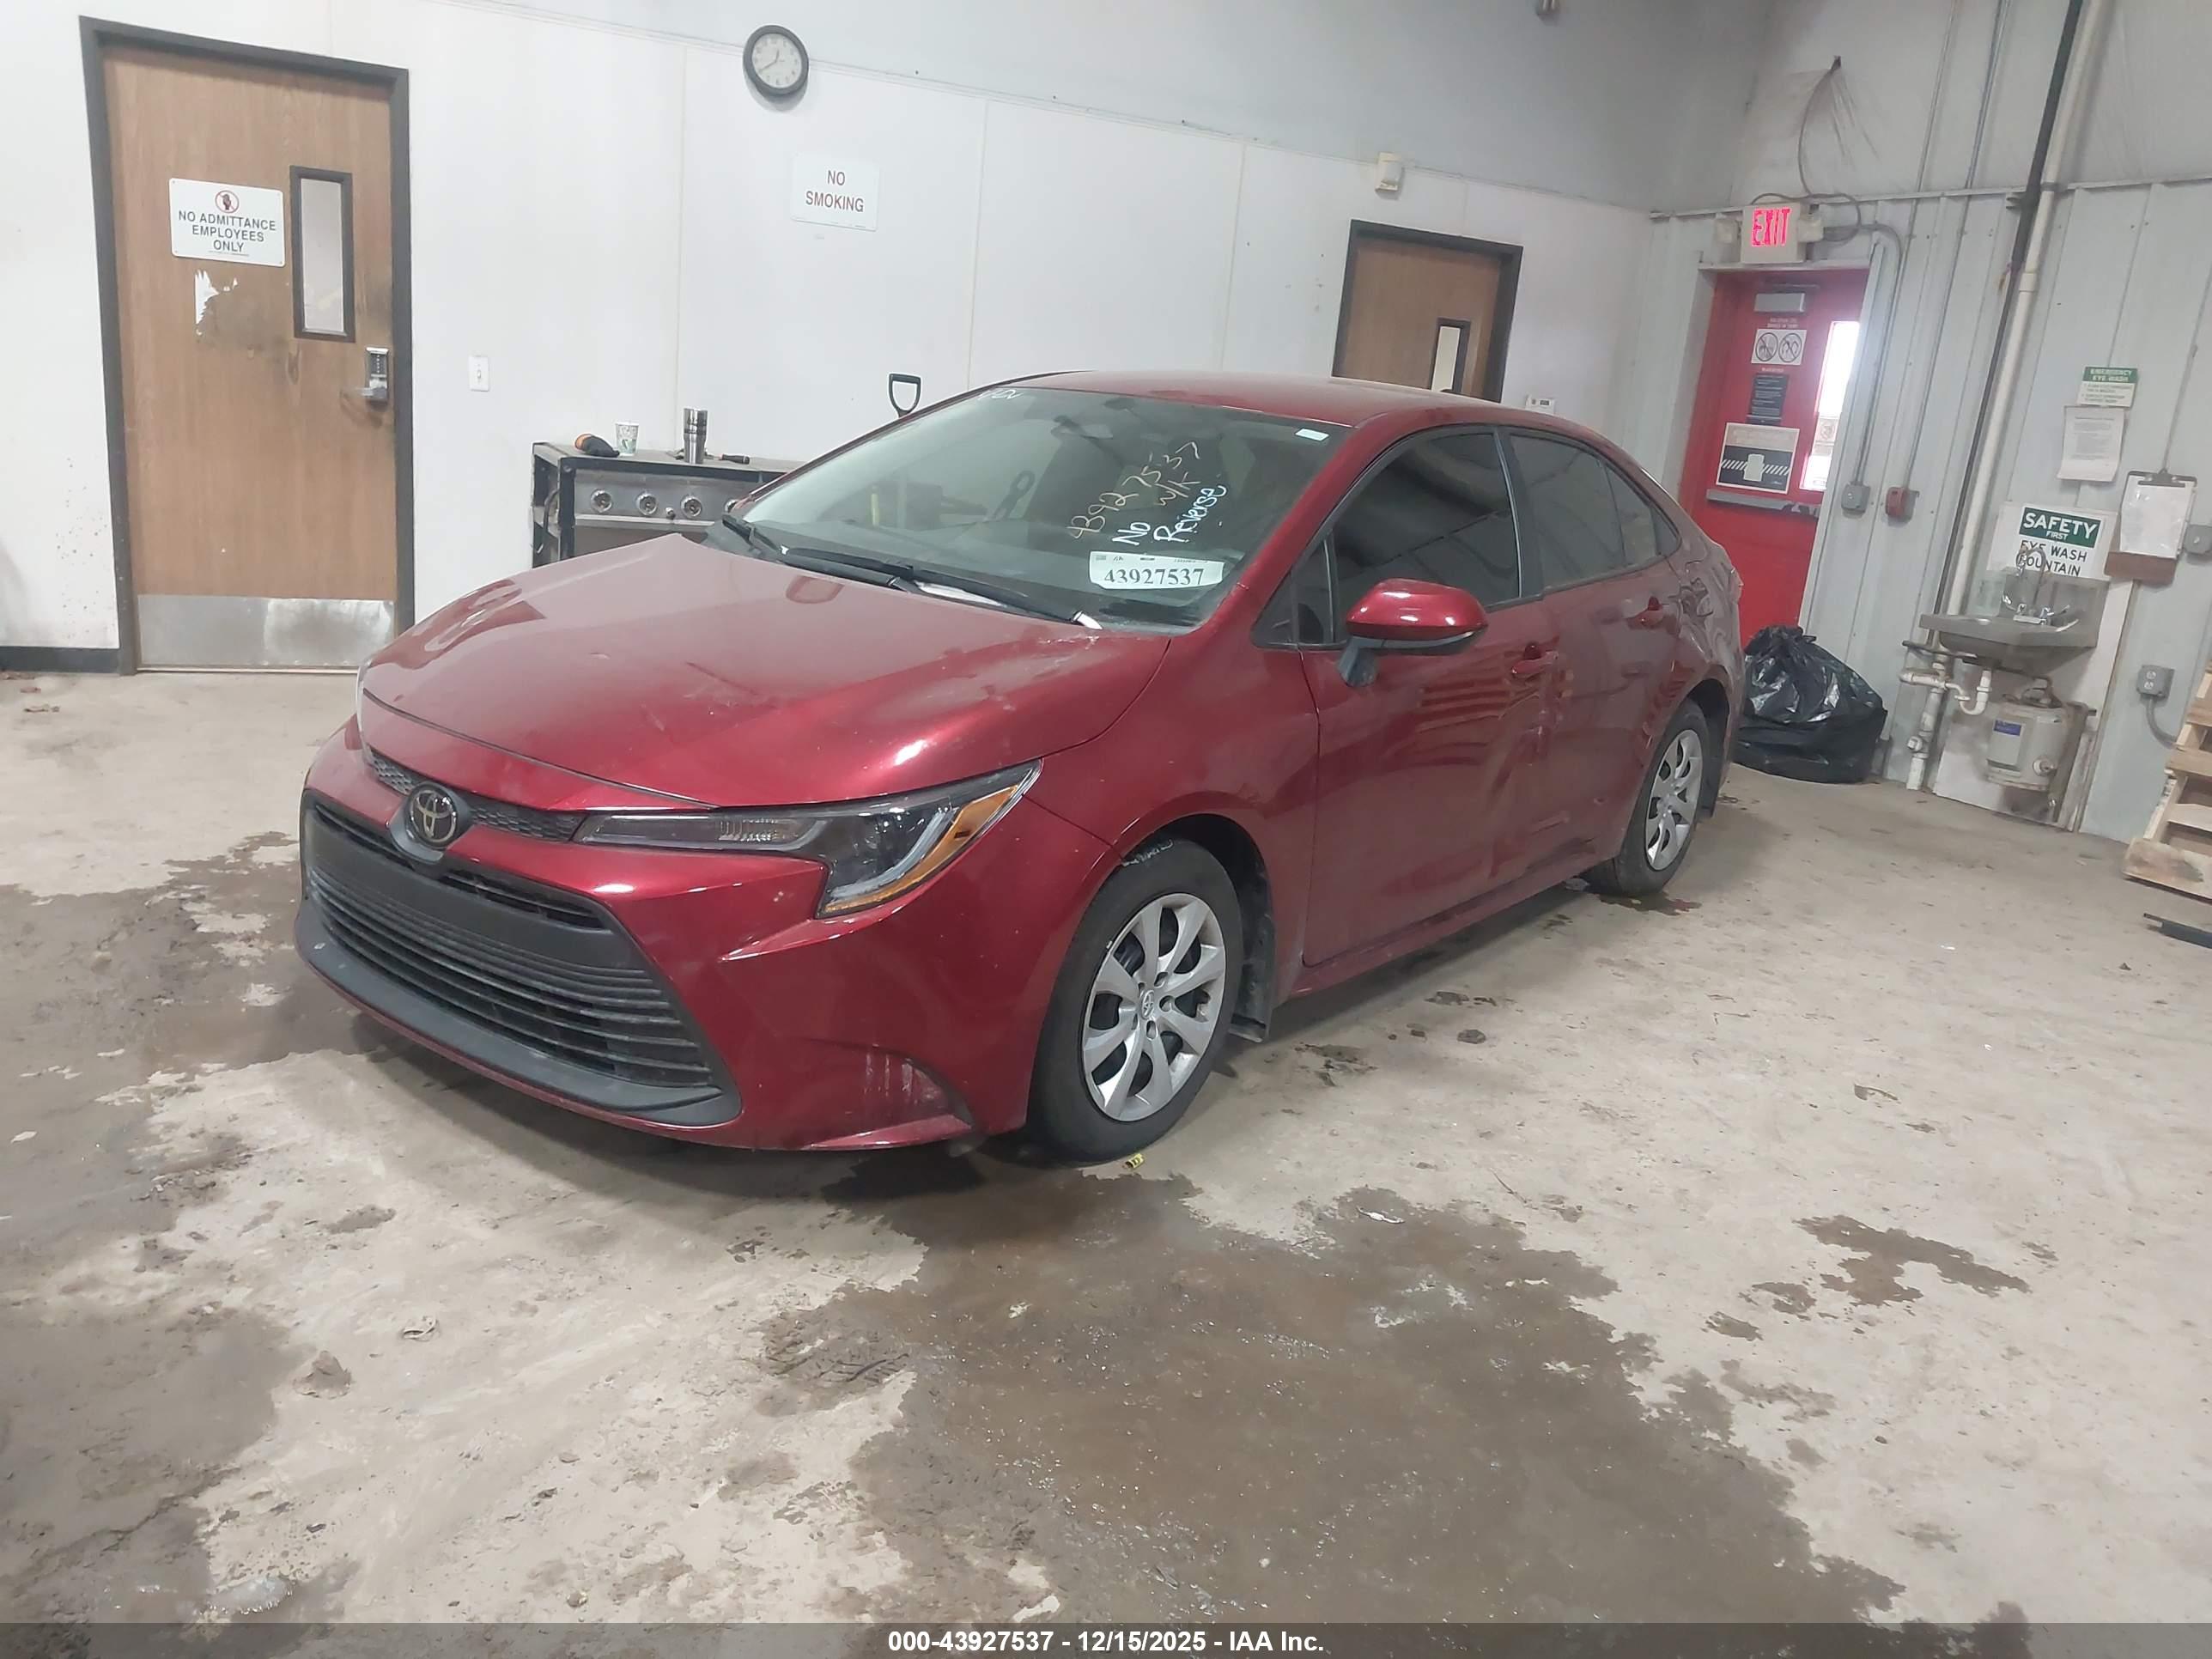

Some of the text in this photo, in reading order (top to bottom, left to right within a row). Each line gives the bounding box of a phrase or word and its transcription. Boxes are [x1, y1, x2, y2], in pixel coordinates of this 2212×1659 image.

[827, 169, 846, 186] NO
[805, 190, 864, 213] SMOKING
[178, 210, 276, 231] NO ADMITTANCE
[1752, 208, 1791, 247] EXIT
[191, 224, 265, 242] EMPLOYEES
[213, 239, 245, 252] ONLY
[2022, 512, 2098, 539] SAFETY
[2045, 530, 2069, 541] FIRST
[2051, 545, 2087, 562] WASH
[1103, 568, 1205, 586] 43927537
